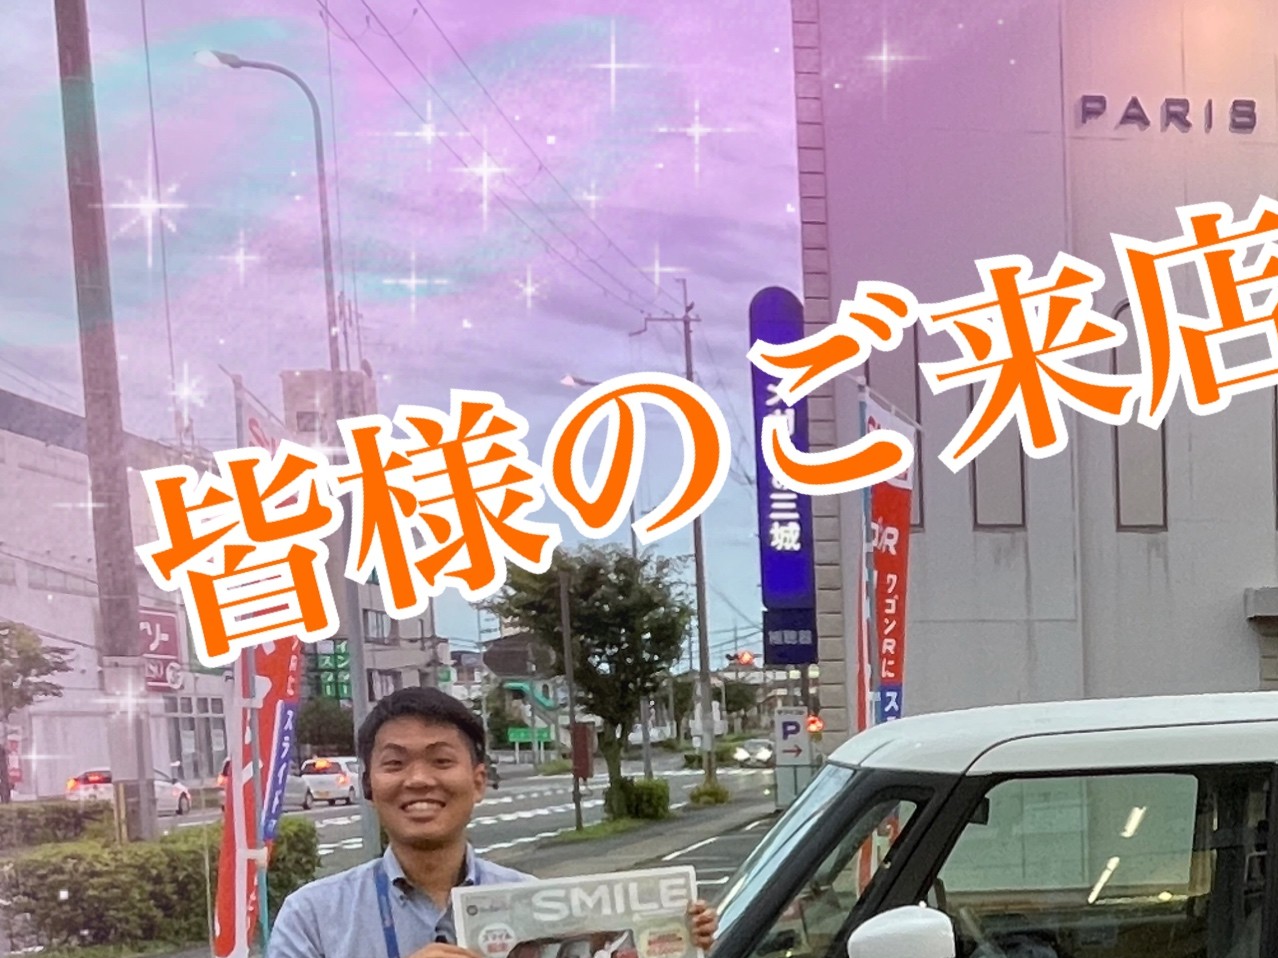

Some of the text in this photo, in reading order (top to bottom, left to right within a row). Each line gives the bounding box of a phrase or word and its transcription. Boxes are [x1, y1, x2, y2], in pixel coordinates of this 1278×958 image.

[1080, 94, 1257, 134] PARIS
[782, 721, 801, 740] P
[531, 877, 690, 922] SMILE
